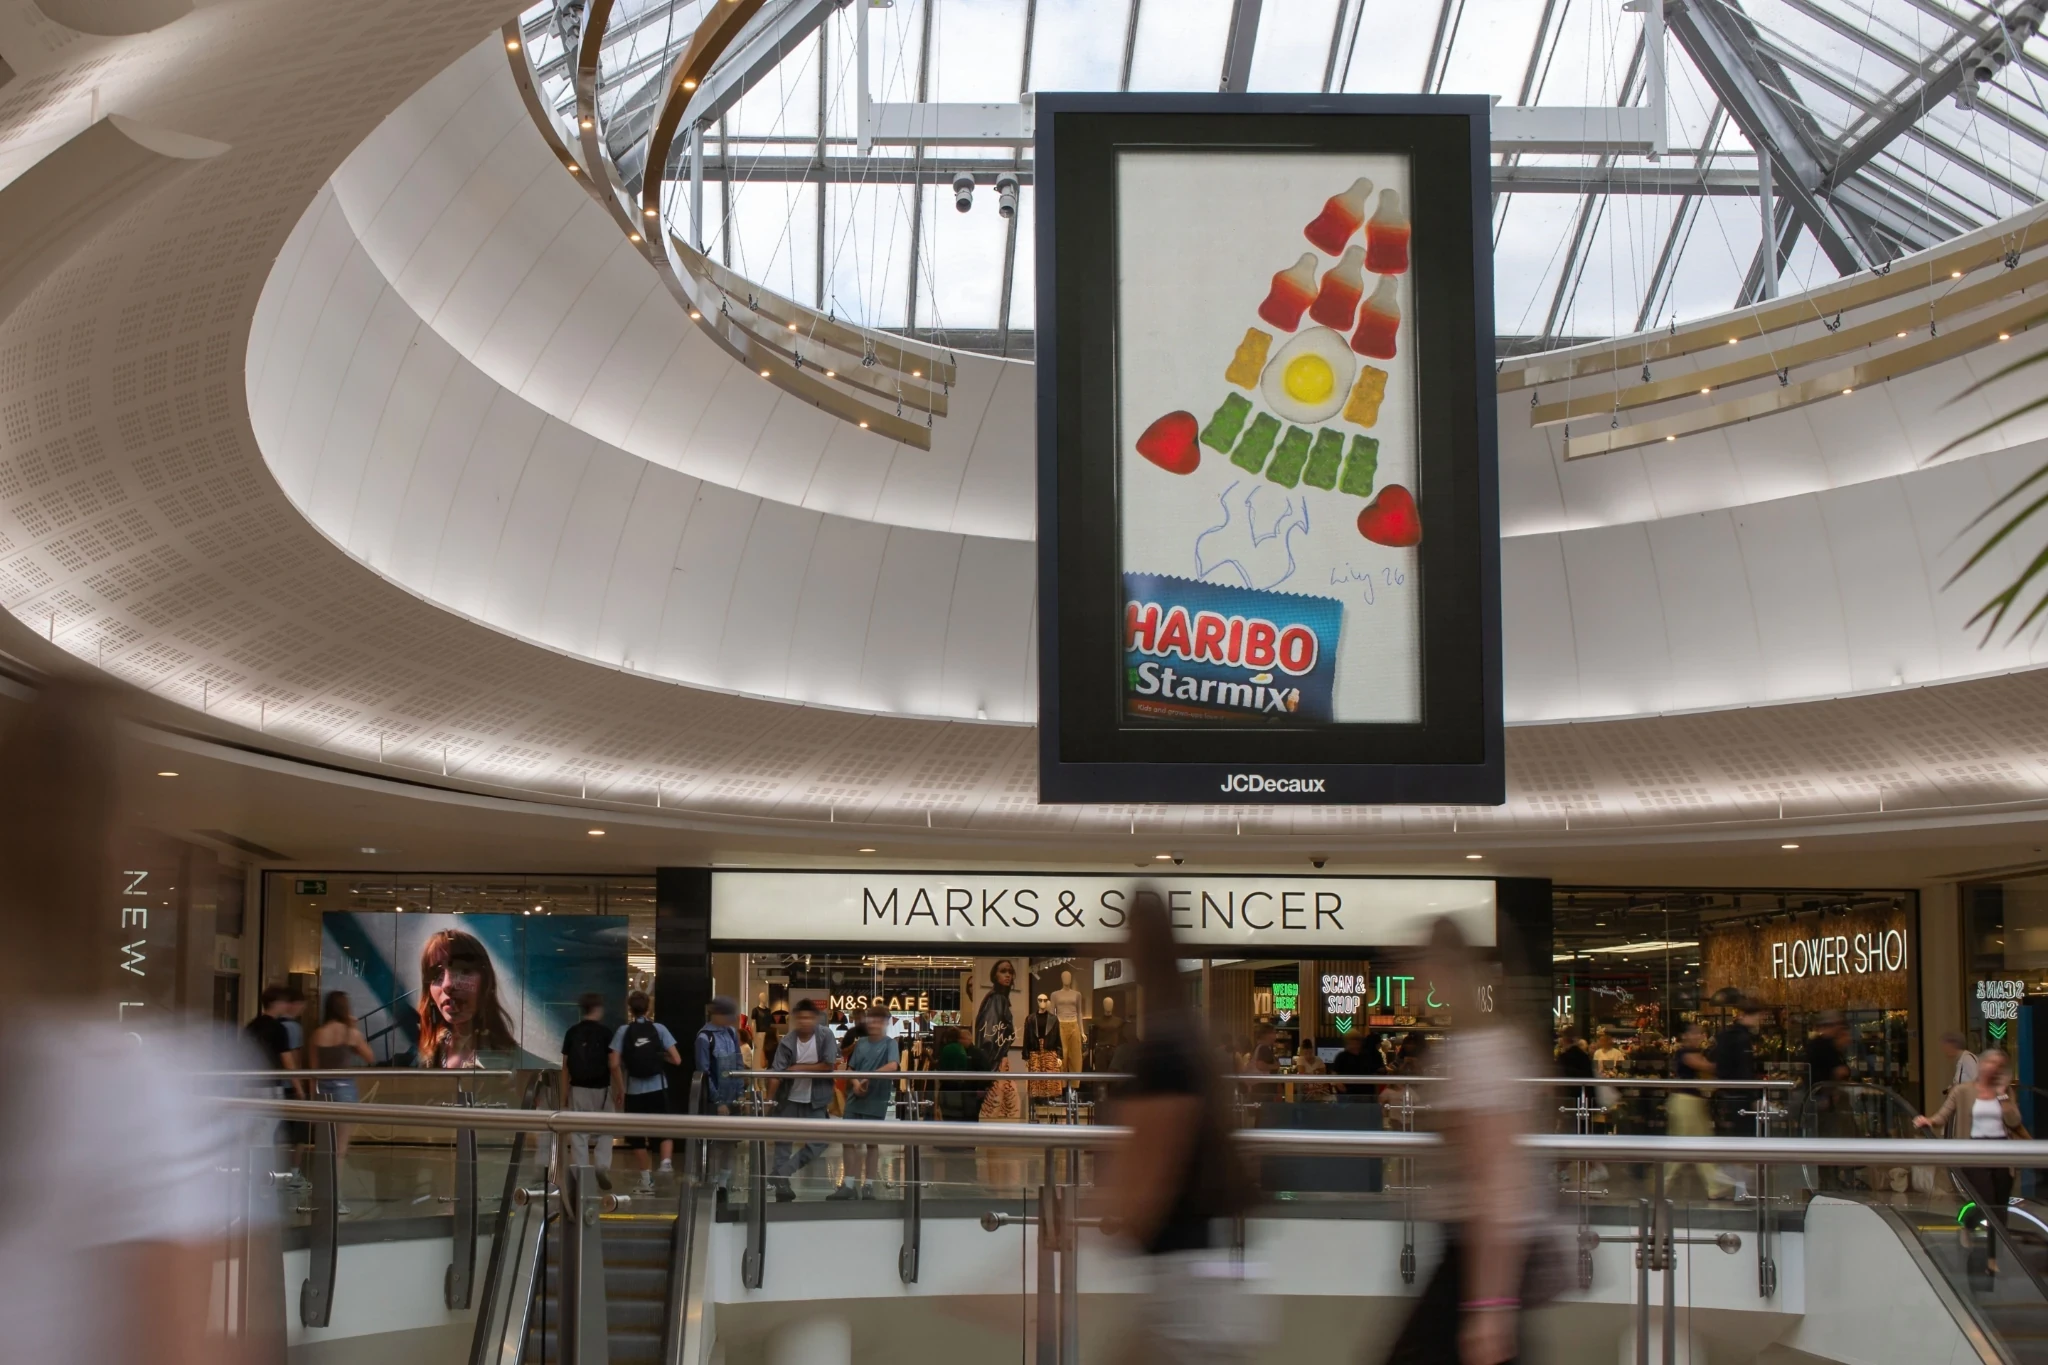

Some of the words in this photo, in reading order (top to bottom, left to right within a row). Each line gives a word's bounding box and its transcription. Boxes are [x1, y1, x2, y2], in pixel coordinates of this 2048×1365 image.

[1124, 602, 1316, 674] HARIBO
[1135, 661, 1291, 713] Starmix
[1137, 704, 1152, 712] Kids
[1220, 774, 1325, 793] JCDecaux
[863, 887, 1040, 927] MARKS
[1054, 889, 1086, 928] &
[120, 870, 149, 976] NEW
[1772, 935, 1849, 979] FLOWER
[1272, 983, 1299, 996] WEIGH
[1322, 974, 1354, 994] SCAN
[1355, 975, 1366, 994] &
[829, 994, 868, 1010] M&S
[872, 991, 929, 1011] CAFÉ
[1275, 996, 1296, 1010] HERE
[1327, 995, 1361, 1014] SHOP
